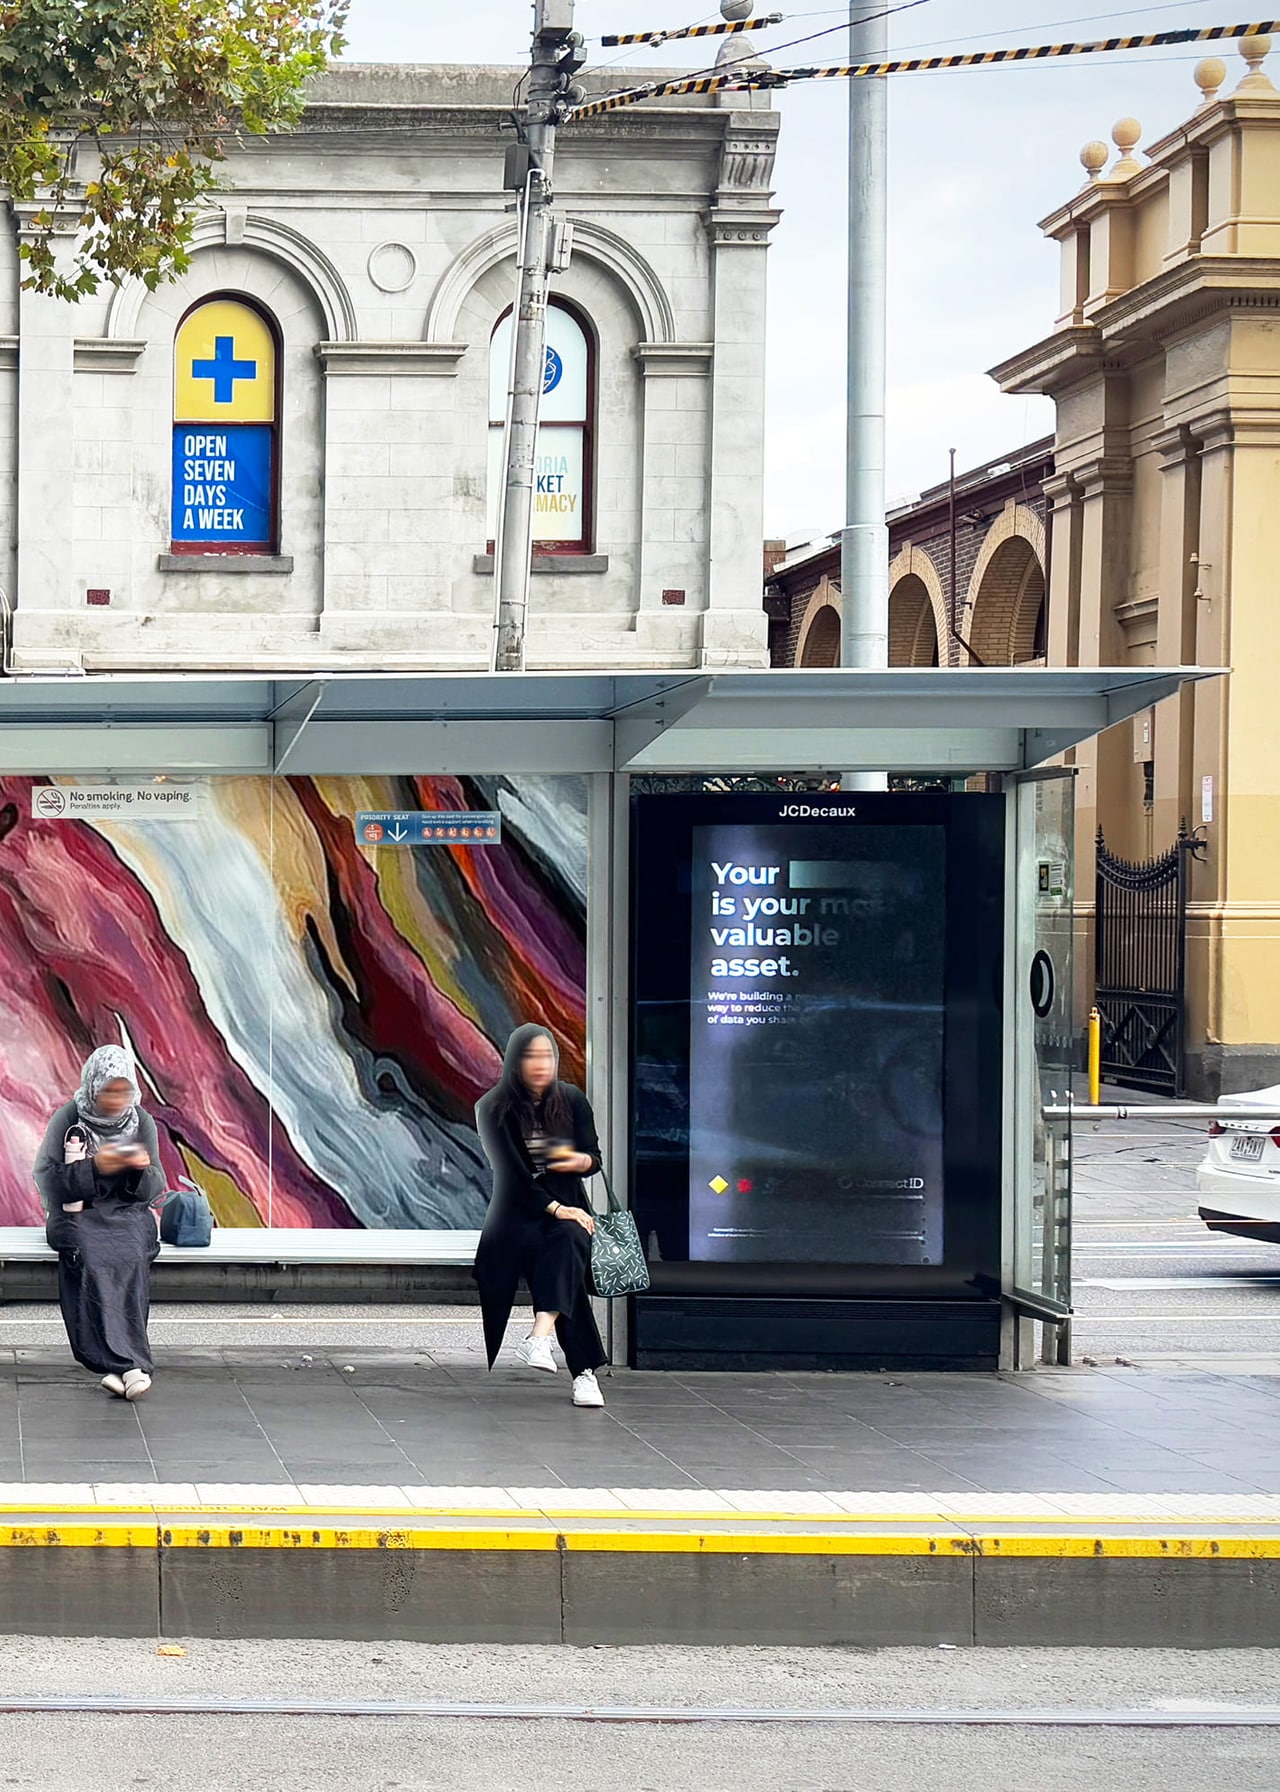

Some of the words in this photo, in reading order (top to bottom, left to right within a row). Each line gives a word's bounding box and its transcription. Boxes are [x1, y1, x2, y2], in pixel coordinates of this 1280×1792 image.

[184, 435, 227, 457] OPEN
[183, 459, 235, 481] SEVEN
[183, 484, 227, 506] DAYS
[182, 508, 195, 530] A
[198, 508, 244, 530] WEEK
[70, 791, 84, 801] No
[87, 791, 135, 803] smoking.
[137, 791, 152, 801] No
[153, 791, 192, 803] vaping.
[70, 802, 101, 810] Penalties
[778, 804, 856, 817] JCDecaux
[710, 862, 781, 886] Your
[711, 890, 737, 916] is
[742, 896, 812, 921] your
[710, 923, 840, 946] valuable
[710, 956, 800, 977] asset.
[707, 991, 738, 1001] We're
[739, 991, 783, 1002] building
[706, 1004, 729, 1014] way
[730, 1003, 743, 1013] to
[744, 1003, 781, 1013] reduce
[706, 1014, 720, 1024] of
[720, 1014, 745, 1024] data
[746, 1016, 766, 1026] you
